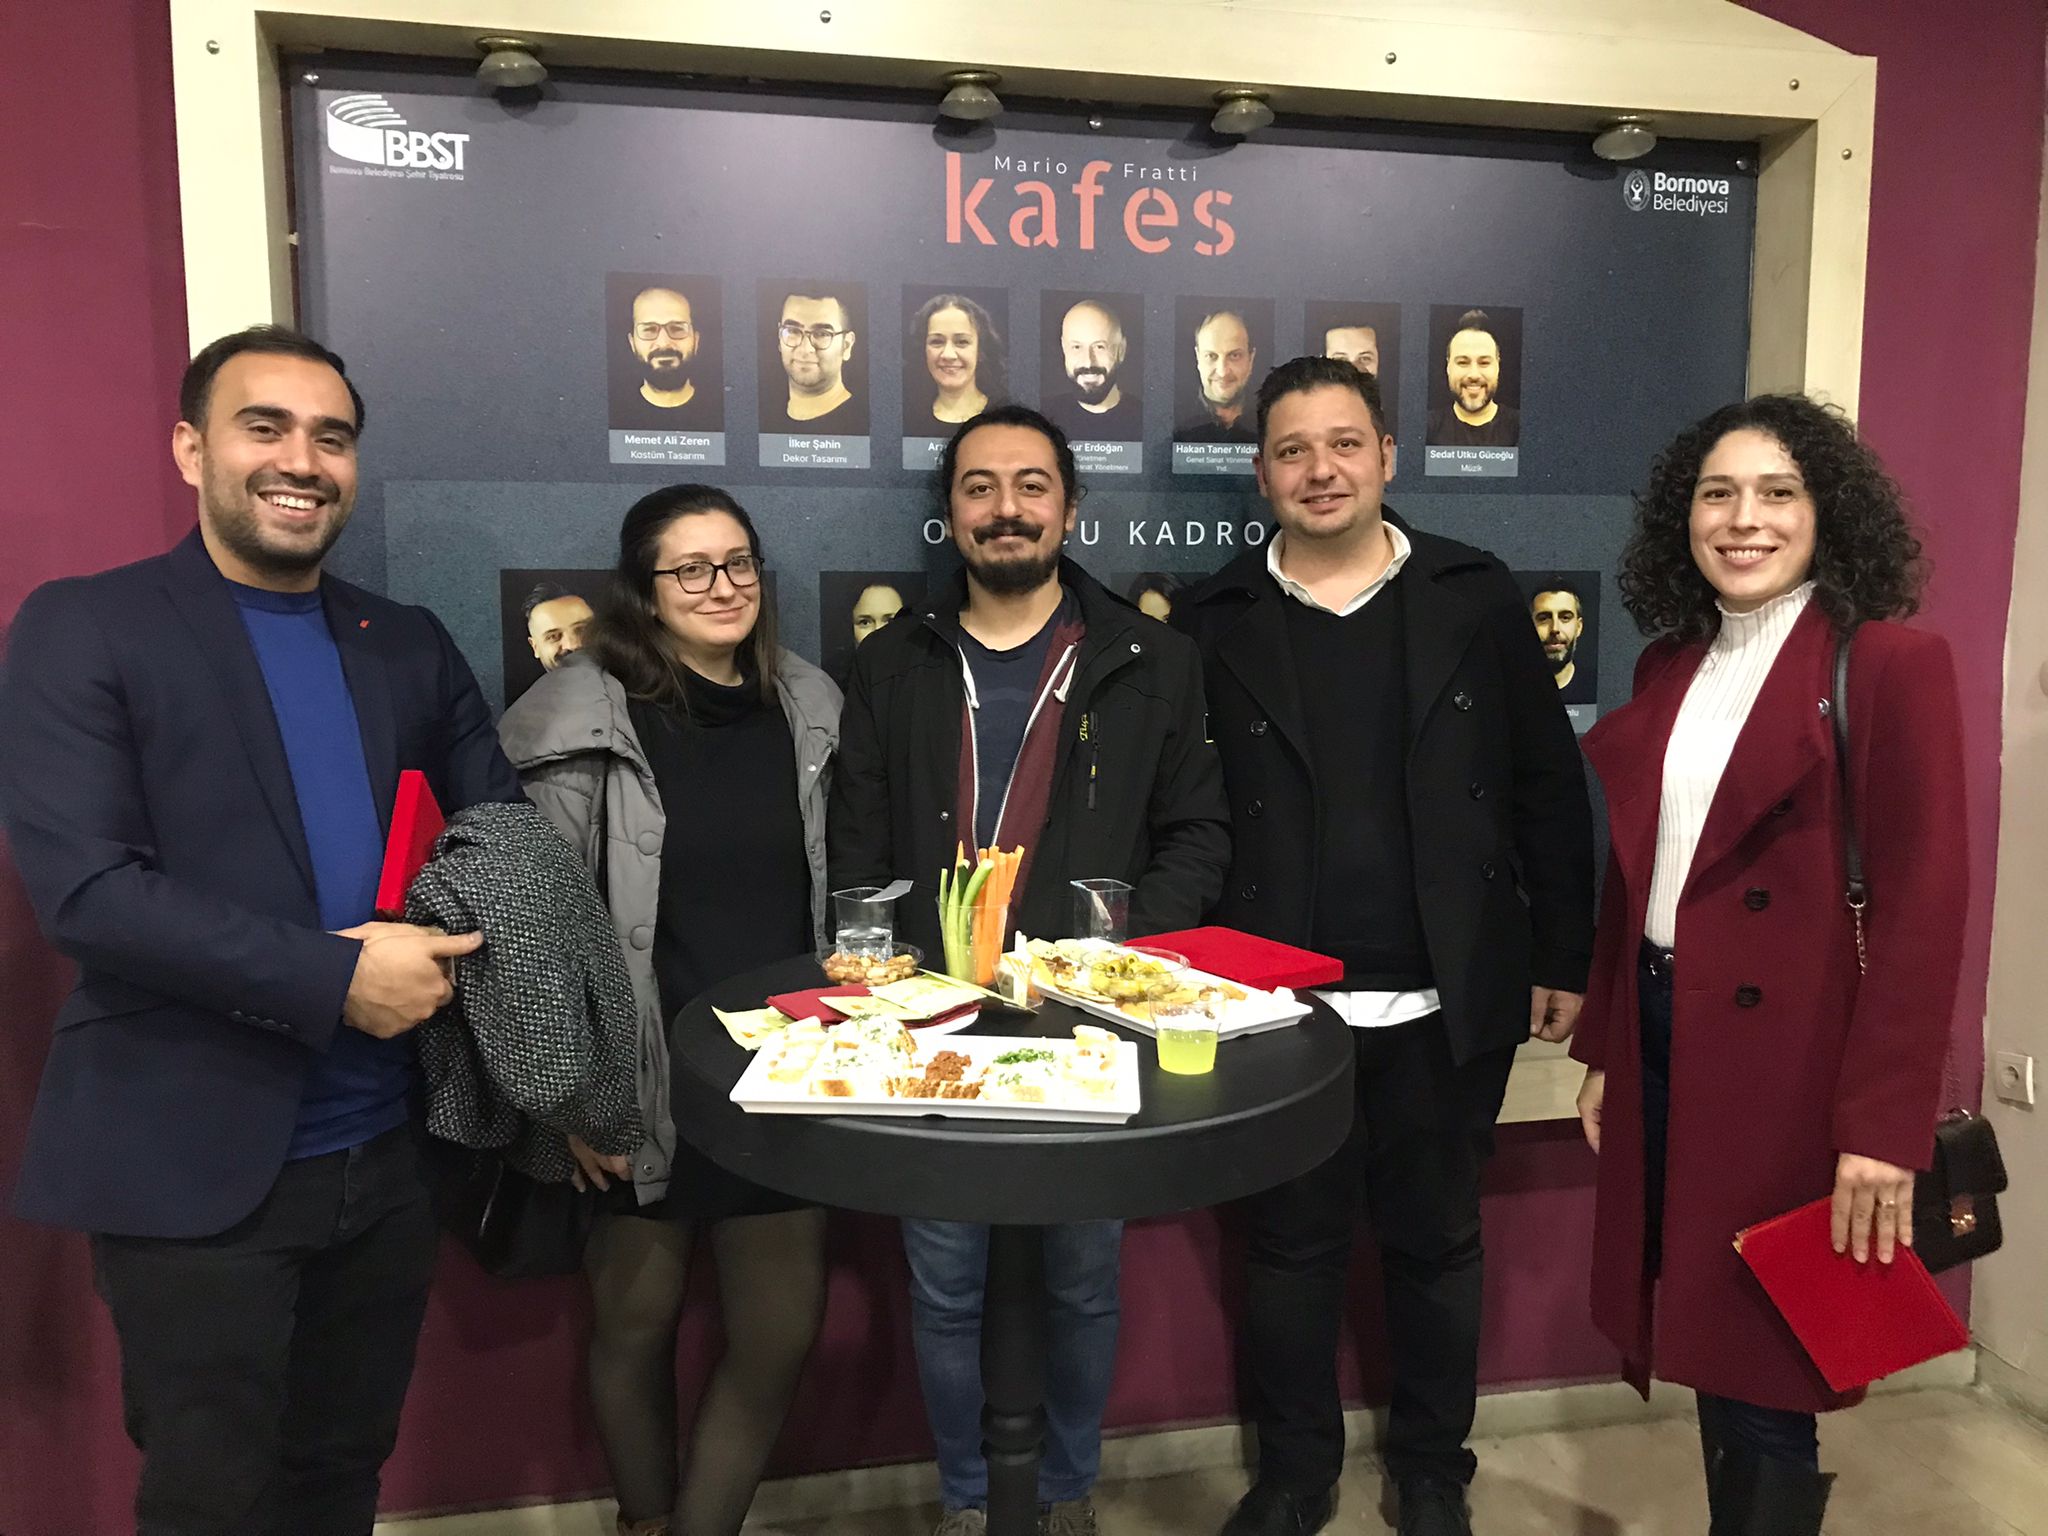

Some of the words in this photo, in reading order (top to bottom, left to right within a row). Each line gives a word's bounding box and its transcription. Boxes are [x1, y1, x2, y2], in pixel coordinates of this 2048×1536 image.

[386, 129, 469, 170] BBST
[995, 156, 1067, 174] Mario
[1124, 163, 1198, 182] Fratti
[1654, 172, 1729, 195] Bornova
[946, 152, 1235, 256] kafes
[1653, 194, 1728, 216] Belediyesi
[624, 434, 661, 445] Memet
[664, 435, 678, 445] Ali
[680, 436, 710, 446] Zeren
[788, 436, 810, 449] İlker
[812, 439, 841, 450] Şahin
[1084, 443, 1123, 455] Erdoğan
[1176, 444, 1205, 454] Hakan
[1207, 444, 1233, 454] Taner
[1430, 449, 1455, 459] Sedat
[1457, 450, 1477, 459] Utku
[630, 450, 665, 460] Kostüm
[667, 451, 705, 461] Tasarımı
[783, 453, 808, 463] Dekor
[811, 454, 847, 463] Tasarımı
[1461, 464, 1482, 472] Müzik
